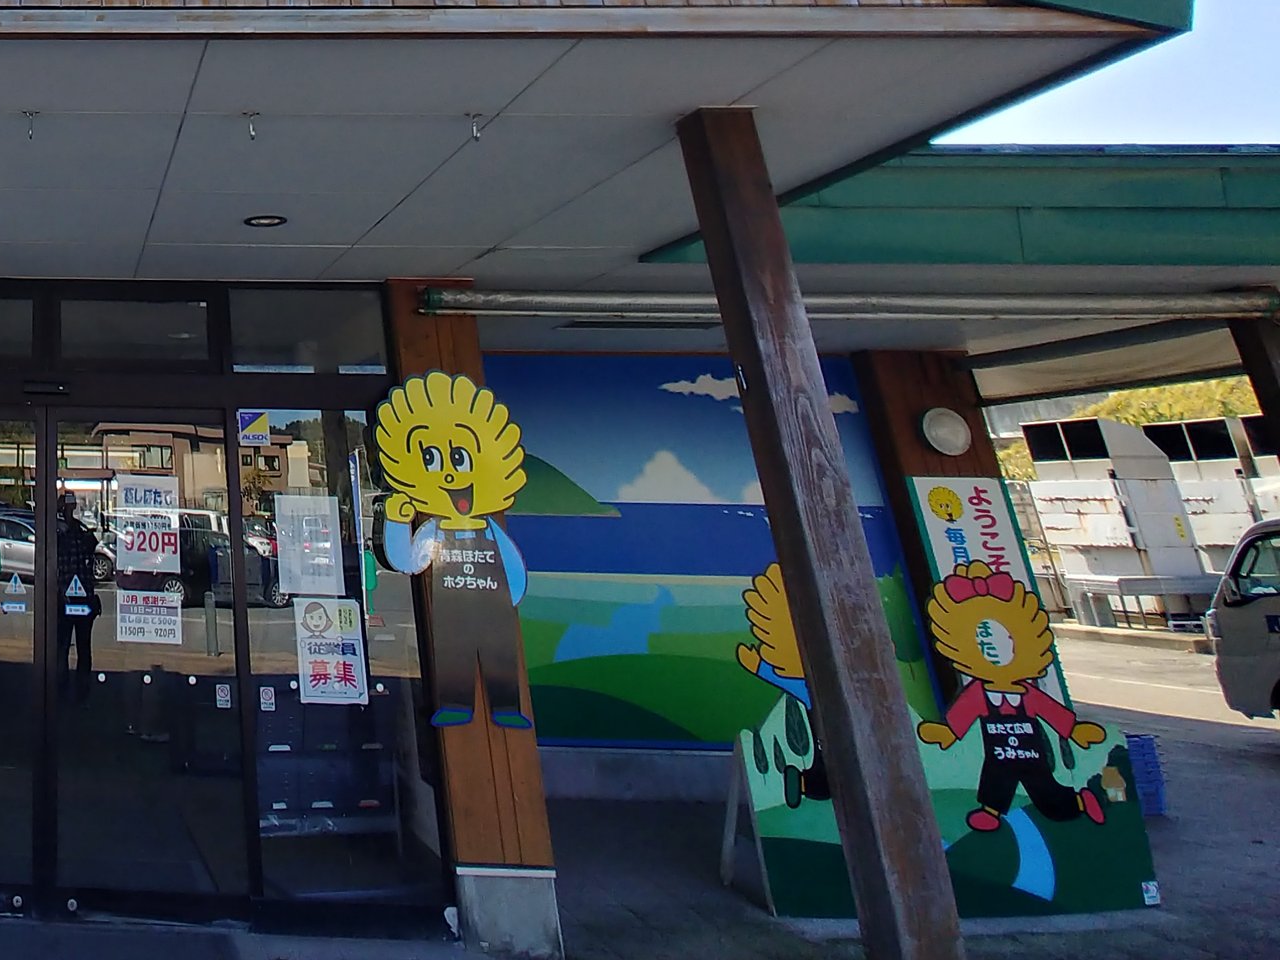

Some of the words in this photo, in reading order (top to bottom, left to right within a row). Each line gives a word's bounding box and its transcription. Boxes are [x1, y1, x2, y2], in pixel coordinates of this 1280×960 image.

[967, 485, 1012, 574] ようこそ
[124, 530, 178, 555] 920円
[440, 549, 496, 563] 青森ほたて
[463, 563, 475, 575] の
[443, 575, 498, 590] ホタちゃん
[120, 626, 146, 637] 1150円
[154, 627, 176, 638] 920円
[307, 641, 358, 657] 従業員
[975, 621, 1002, 667] ほた
[308, 659, 358, 689] 募集
[986, 722, 1034, 735] ほたて広場
[1008, 736, 1019, 747] の
[993, 746, 1040, 760] うみちゃん
